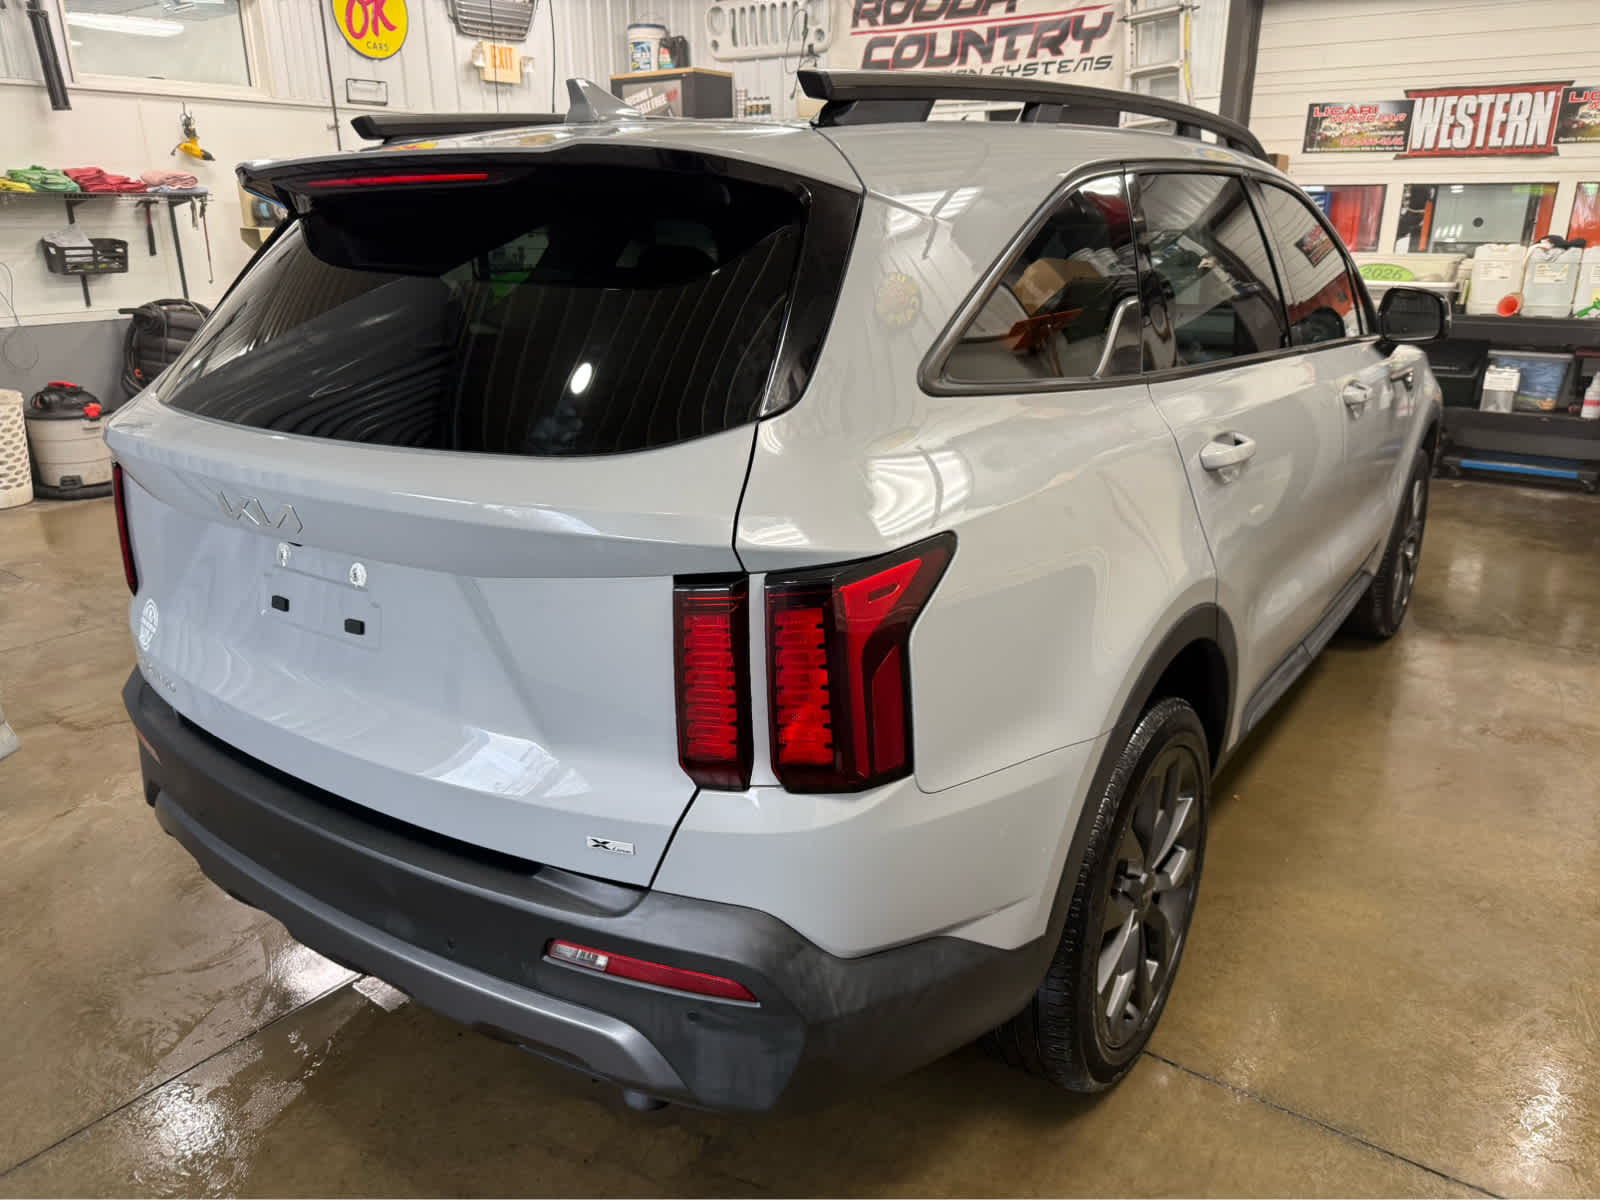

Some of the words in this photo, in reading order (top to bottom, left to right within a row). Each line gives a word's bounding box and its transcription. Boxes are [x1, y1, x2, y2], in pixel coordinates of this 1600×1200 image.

[345, 0, 397, 39] OK
[490, 45, 513, 71] EXIT
[861, 11, 1115, 71] COUNTRY
[990, 55, 1113, 77] SYSTEMS
[1409, 90, 1557, 150] WESTERN
